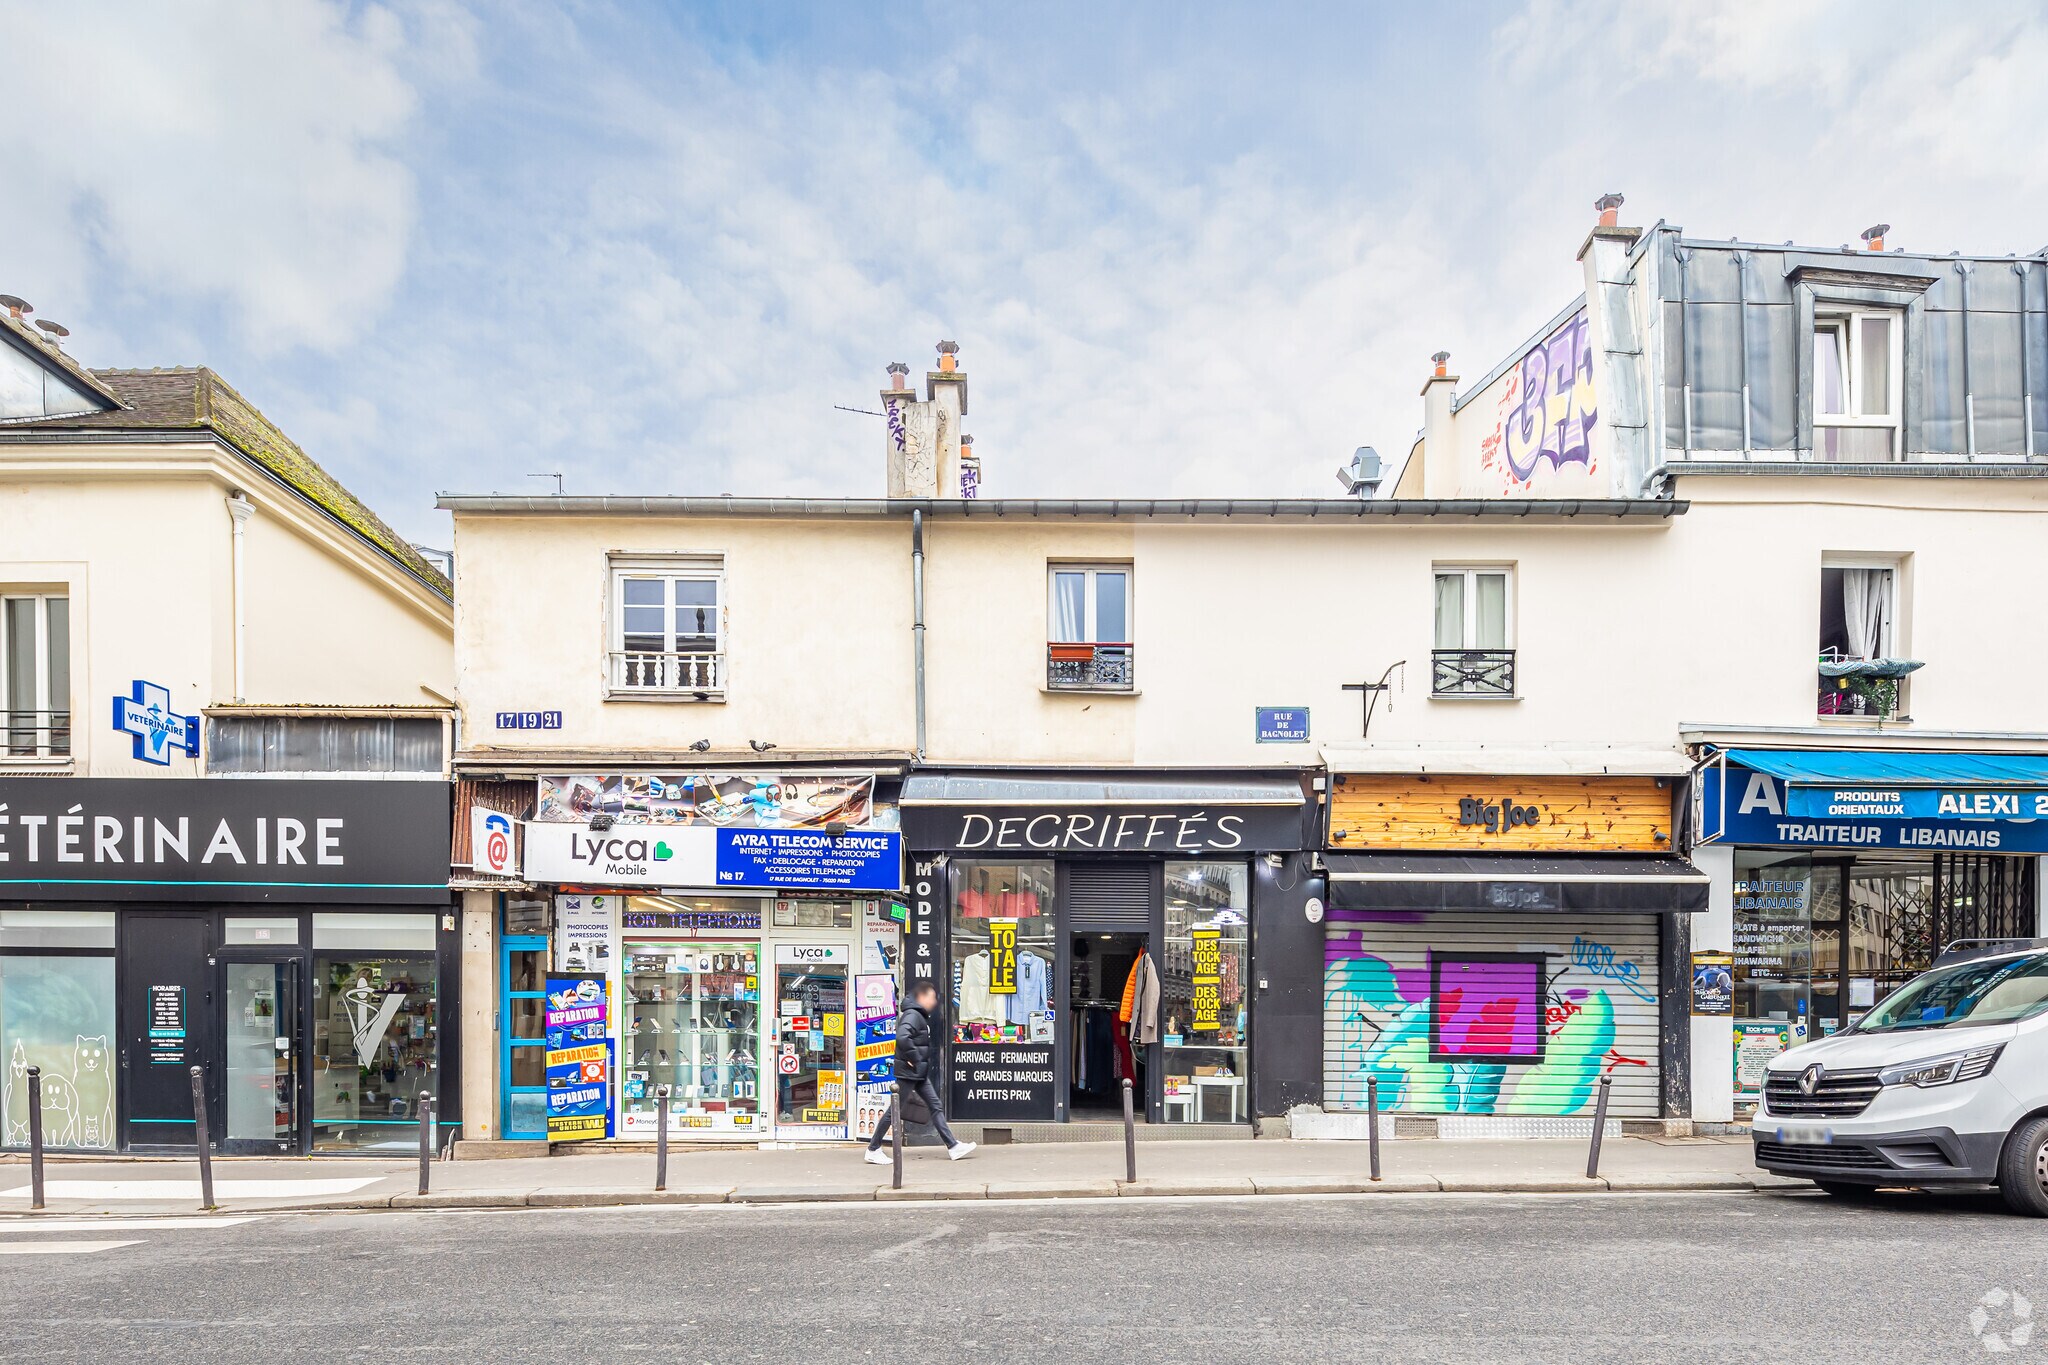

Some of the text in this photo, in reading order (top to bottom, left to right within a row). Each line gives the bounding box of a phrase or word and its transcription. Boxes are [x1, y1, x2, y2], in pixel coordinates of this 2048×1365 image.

[127, 711, 183, 737] VETERINAIRE
[499, 713, 559, 728] 17 19 21
[1261, 730, 1305, 738] BAGNOLET
[1834, 791, 1900, 802] PRODUITS
[1459, 797, 1540, 833] Big Joe
[1829, 804, 1904, 815] ORIENTAUX
[956, 811, 1244, 849] DEGRIFFÉS
[1777, 823, 2000, 847] TRAITEUR LIBANAIS
[731, 834, 888, 850] AYRA TELECOM SERVICE
[571, 833, 648, 866] Lyca
[740, 847, 881, 858] INTERNET IMPRESSIONS PHOTOCOPIES
[753, 856, 865, 867] FAX DEBLOCAGE REPARATION
[605, 863, 647, 876] Mobile
[735, 871, 745, 880] 17
[764, 866, 856, 876] ACCESSOIRES TELEPHONES
[778, 902, 788, 910] 17
[1733, 897, 1803, 909] LIBANAIS
[1767, 924, 1805, 932] emporter
[990, 929, 1015, 949] TO
[1196, 940, 1217, 951] DES
[793, 946, 823, 960] Lyca
[990, 949, 1016, 967] TA
[1192, 951, 1220, 963] TOCK
[1195, 963, 1217, 974] AGE
[992, 968, 1014, 986] LE
[1196, 986, 1217, 998] DES
[1192, 998, 1220, 1009] TOCK
[549, 1006, 599, 1025] REPARATION
[856, 1005, 895, 1021] REPARATION
[1195, 1009, 1217, 1021] AGE
[551, 1046, 600, 1065] REPARATION
[857, 1044, 895, 1059] REPARATION
[955, 1051, 1049, 1064] ARRIVAGE PERMANENT
[955, 1070, 1053, 1083] DE GRANDES MARQUES
[550, 1087, 601, 1107] REPARATION
[967, 1089, 1031, 1101] A PETITS PRIX
[548, 1120, 583, 1128] WESTERN
